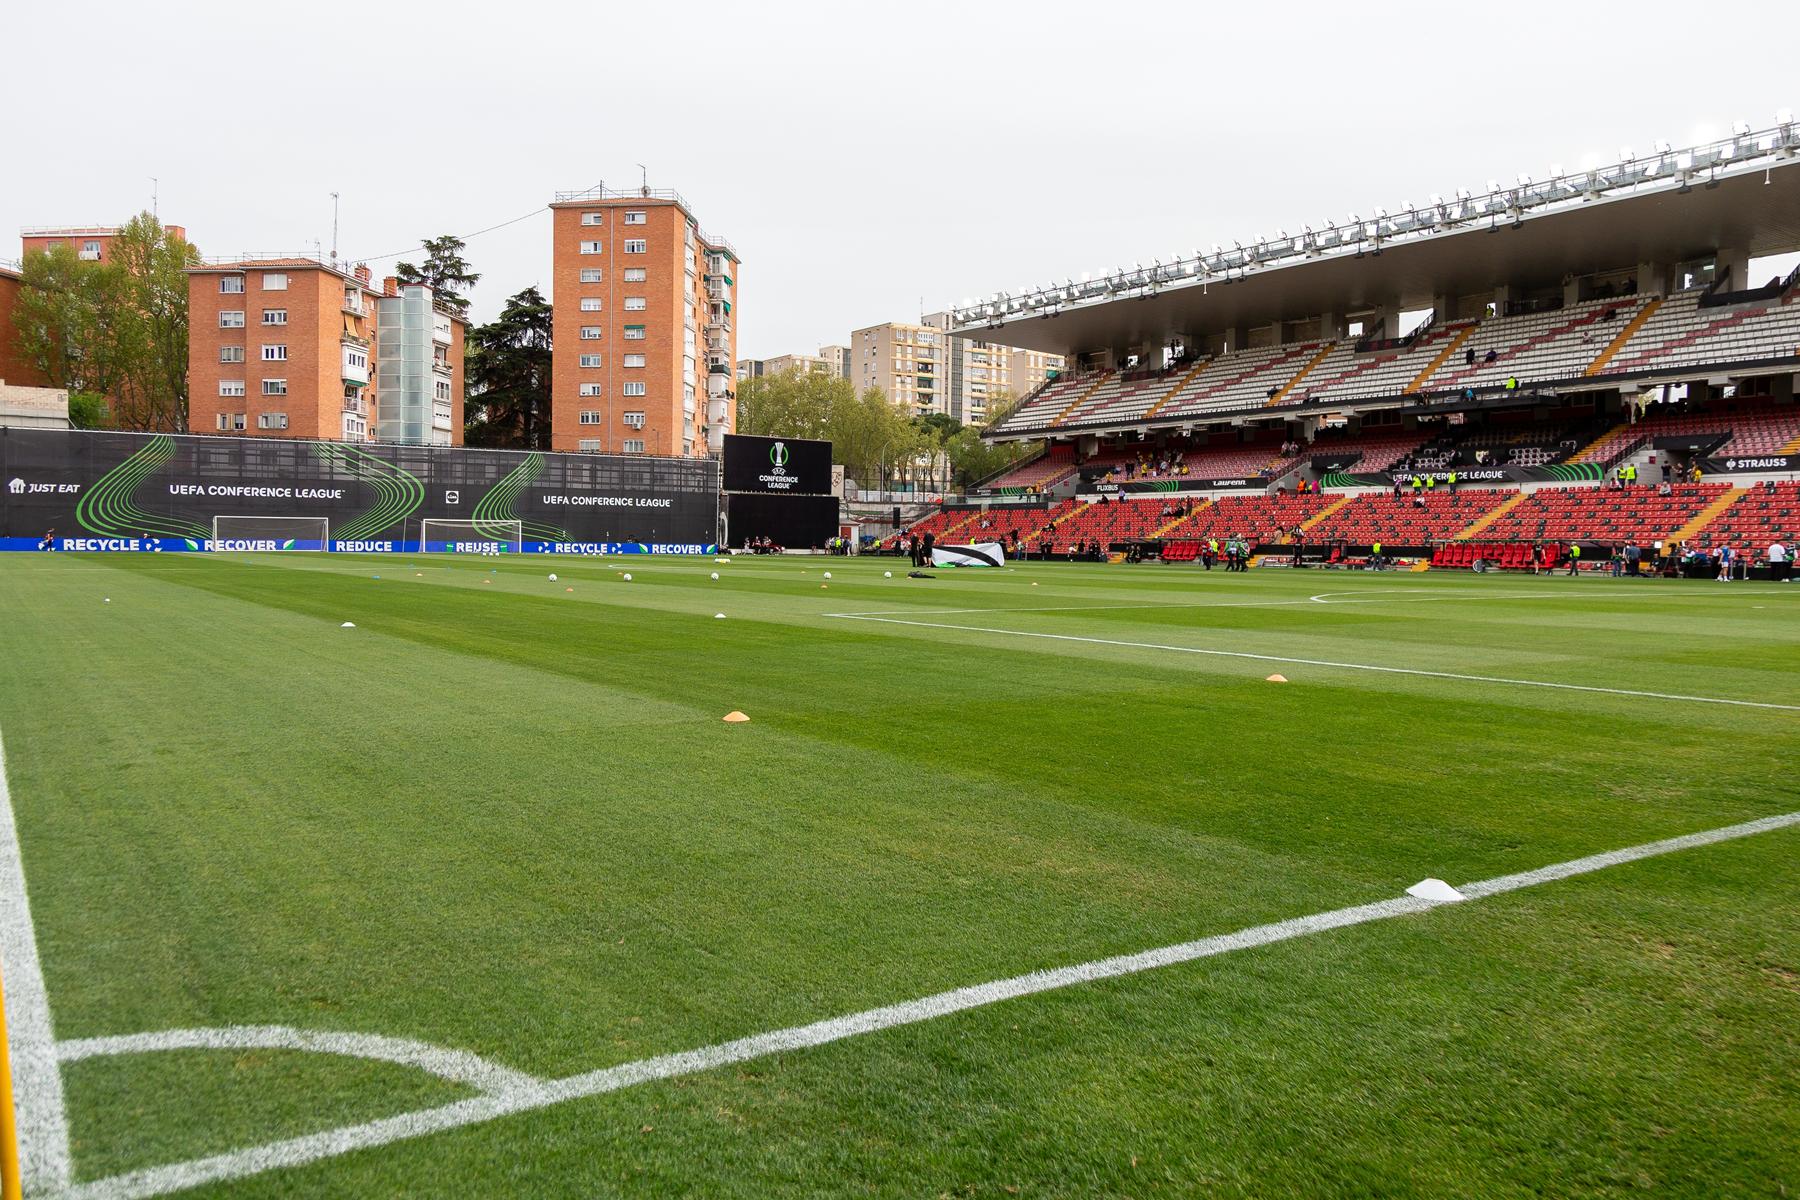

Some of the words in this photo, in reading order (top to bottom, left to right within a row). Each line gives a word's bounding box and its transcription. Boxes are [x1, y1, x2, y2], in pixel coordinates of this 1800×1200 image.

[1738, 458, 1787, 468] STRAUSS
[758, 475, 799, 484] CONFERENCE
[1469, 470, 1503, 480] LEAGUE
[28, 483, 57, 494] JUST
[58, 484, 81, 493] EAT
[169, 484, 206, 496] UEFA
[208, 485, 292, 498] CONFERENCE
[295, 488, 342, 499] LEAGUE
[767, 482, 790, 490] LEAGUE
[1096, 484, 1119, 492] FLIXBUS
[543, 495, 570, 505] UEFA
[571, 496, 634, 507] CONFERENCE
[635, 498, 671, 507] LEAGUE
[63, 538, 140, 551] RECYCLE
[204, 539, 277, 552] RECOVER
[336, 541, 392, 552] REDUCE
[456, 542, 499, 553] REUSE
[555, 543, 608, 554] RECYCLE
[652, 544, 702, 555] RECOVER
